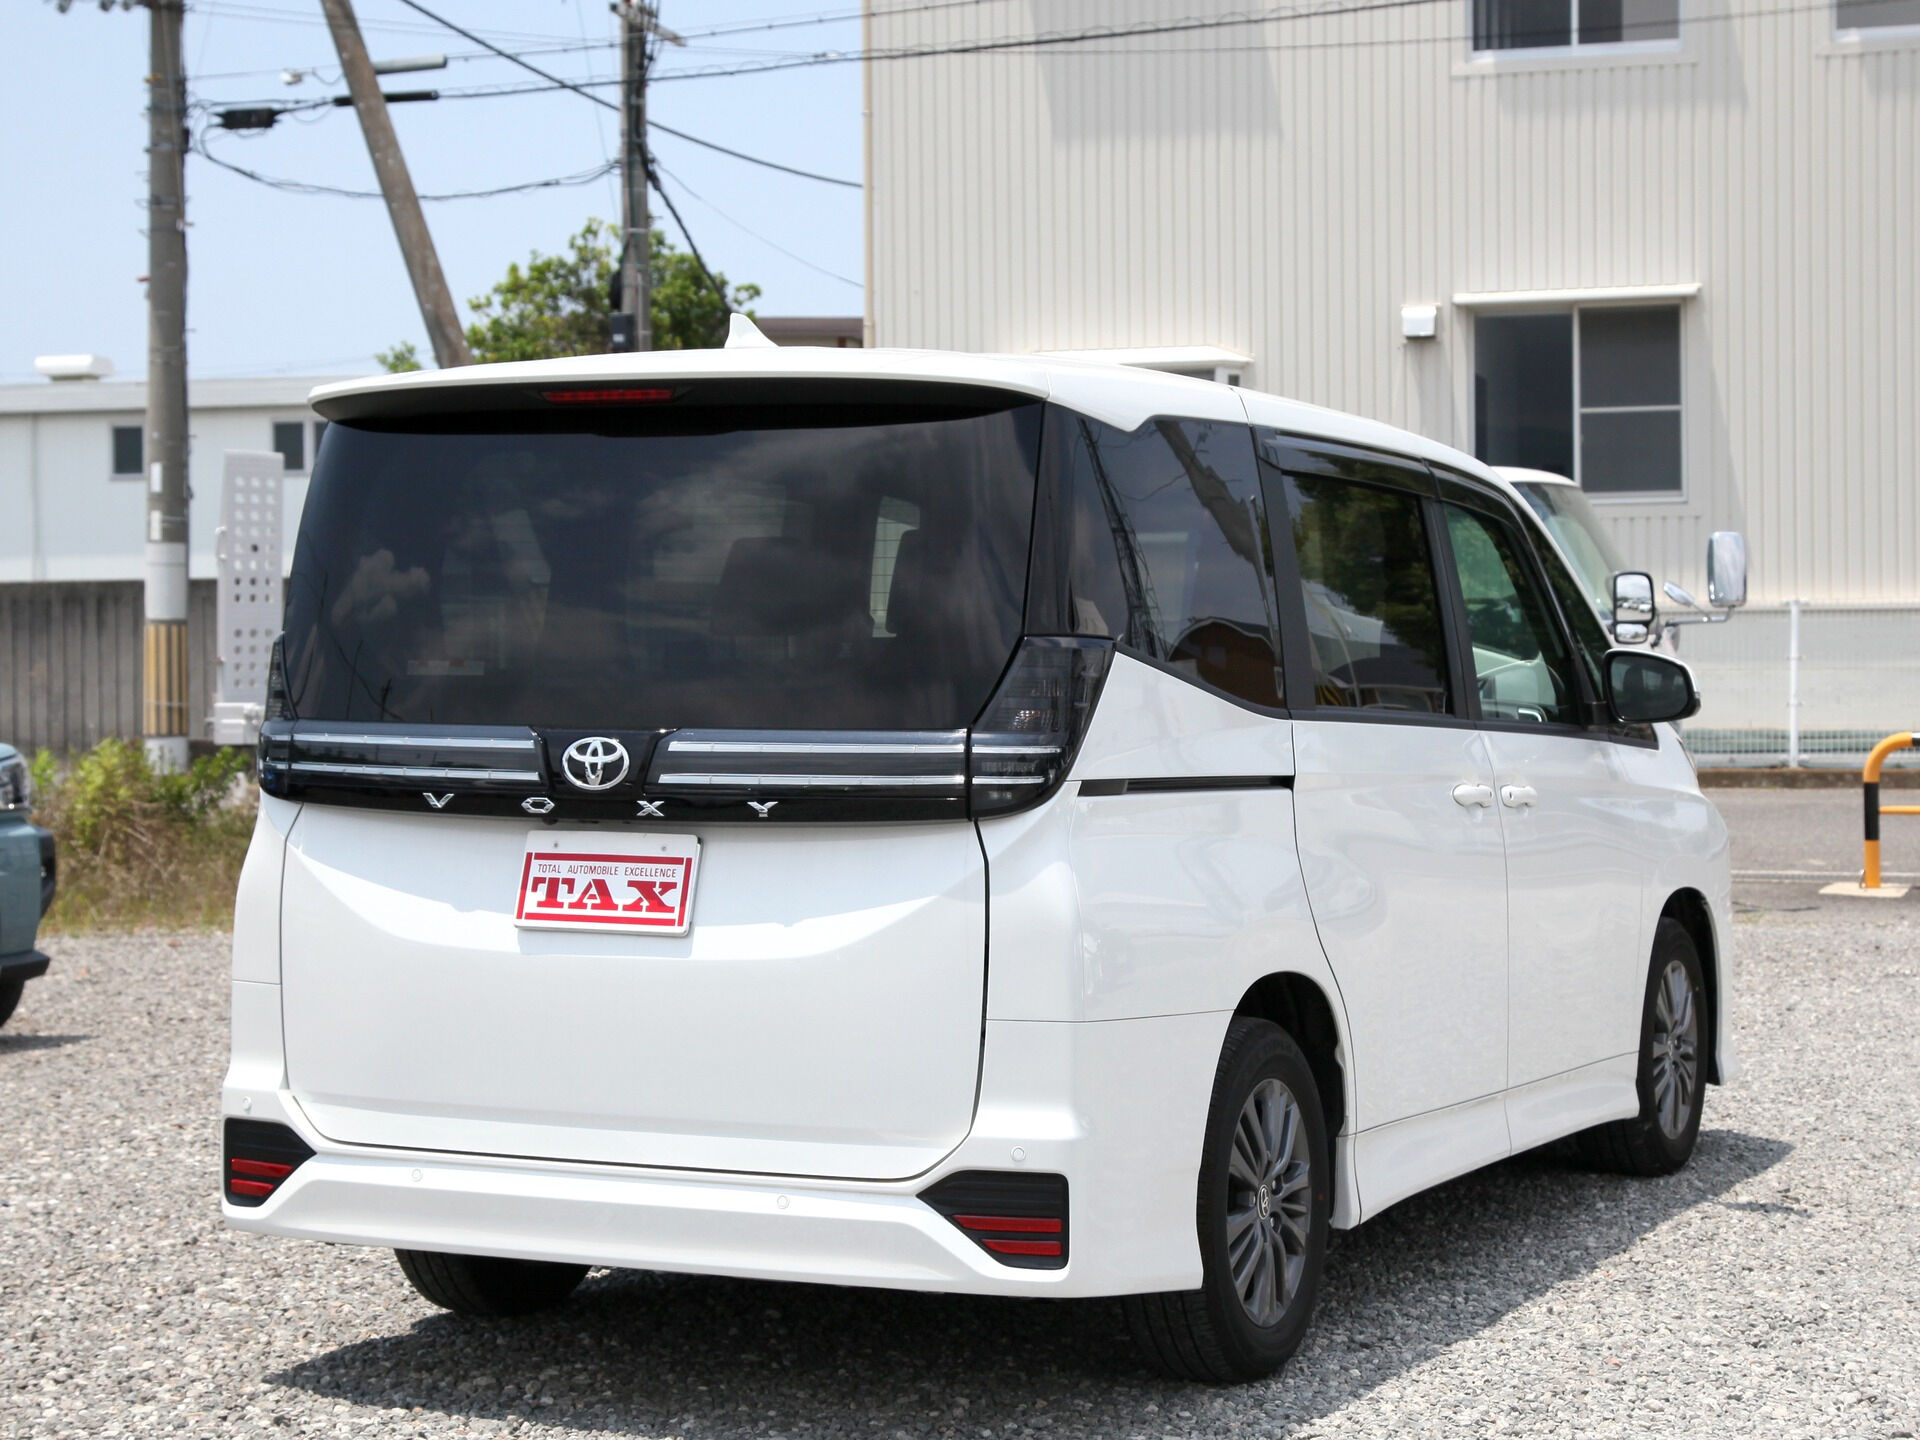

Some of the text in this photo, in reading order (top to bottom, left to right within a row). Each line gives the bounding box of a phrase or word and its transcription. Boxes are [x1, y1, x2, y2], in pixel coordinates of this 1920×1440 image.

[422, 792, 778, 818] VOXY
[537, 863, 677, 878] TOTAL AUTOMOBILE EXCELLENCE
[531, 876, 677, 913] TAX
